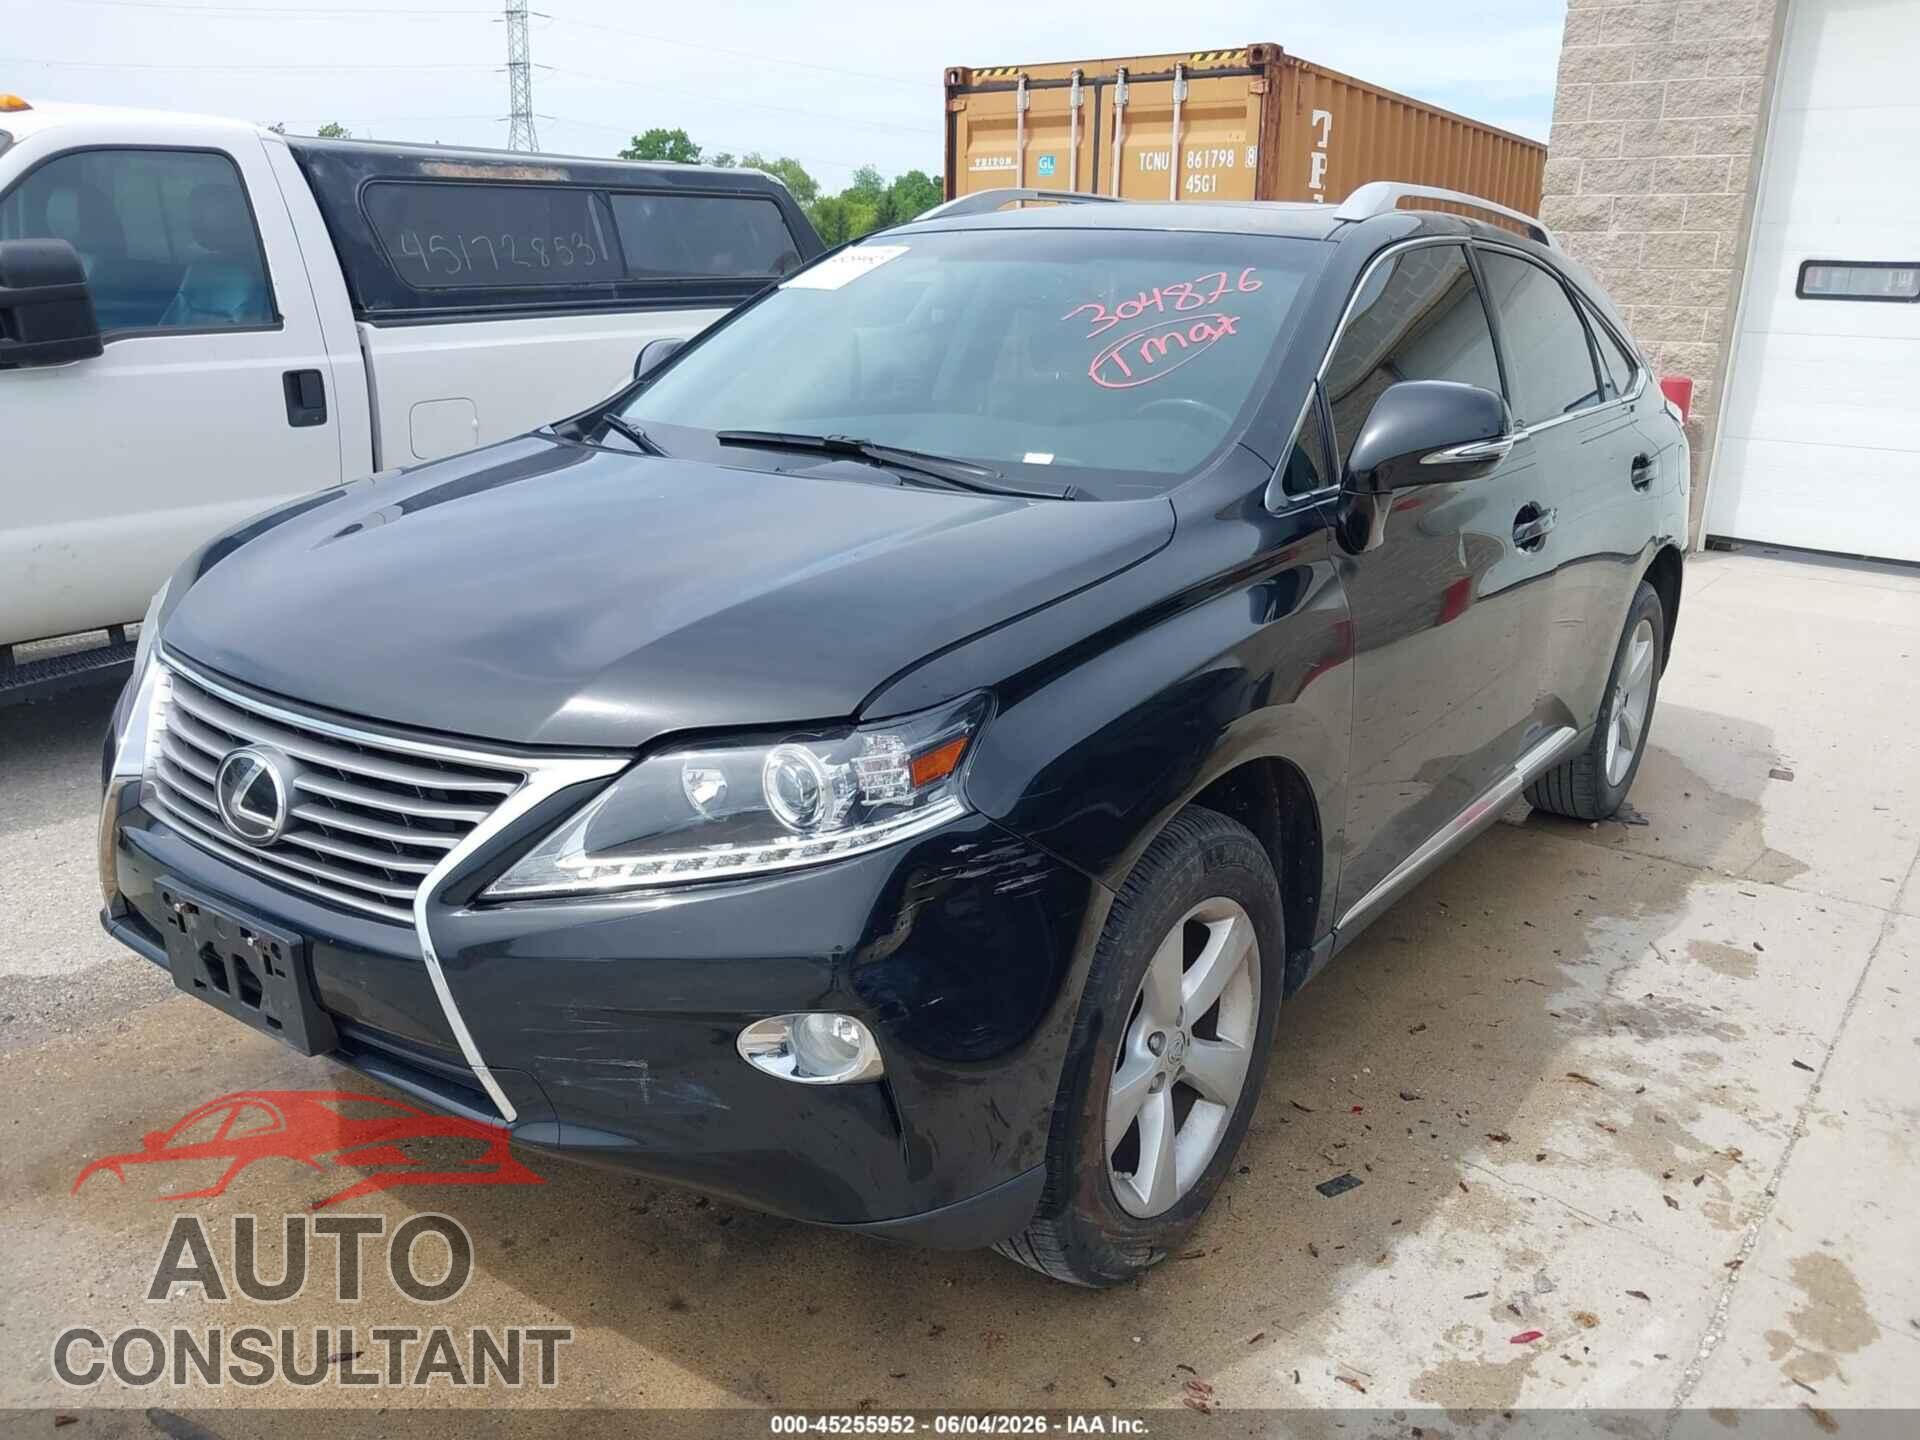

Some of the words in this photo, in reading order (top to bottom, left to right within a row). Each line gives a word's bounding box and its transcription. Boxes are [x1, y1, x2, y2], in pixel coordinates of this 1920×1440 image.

[1139, 152, 1169, 170] TCNU
[1186, 150, 1234, 169] 861798
[1186, 174, 1217, 192] 45G1
[1061, 267, 1263, 338] 304876
